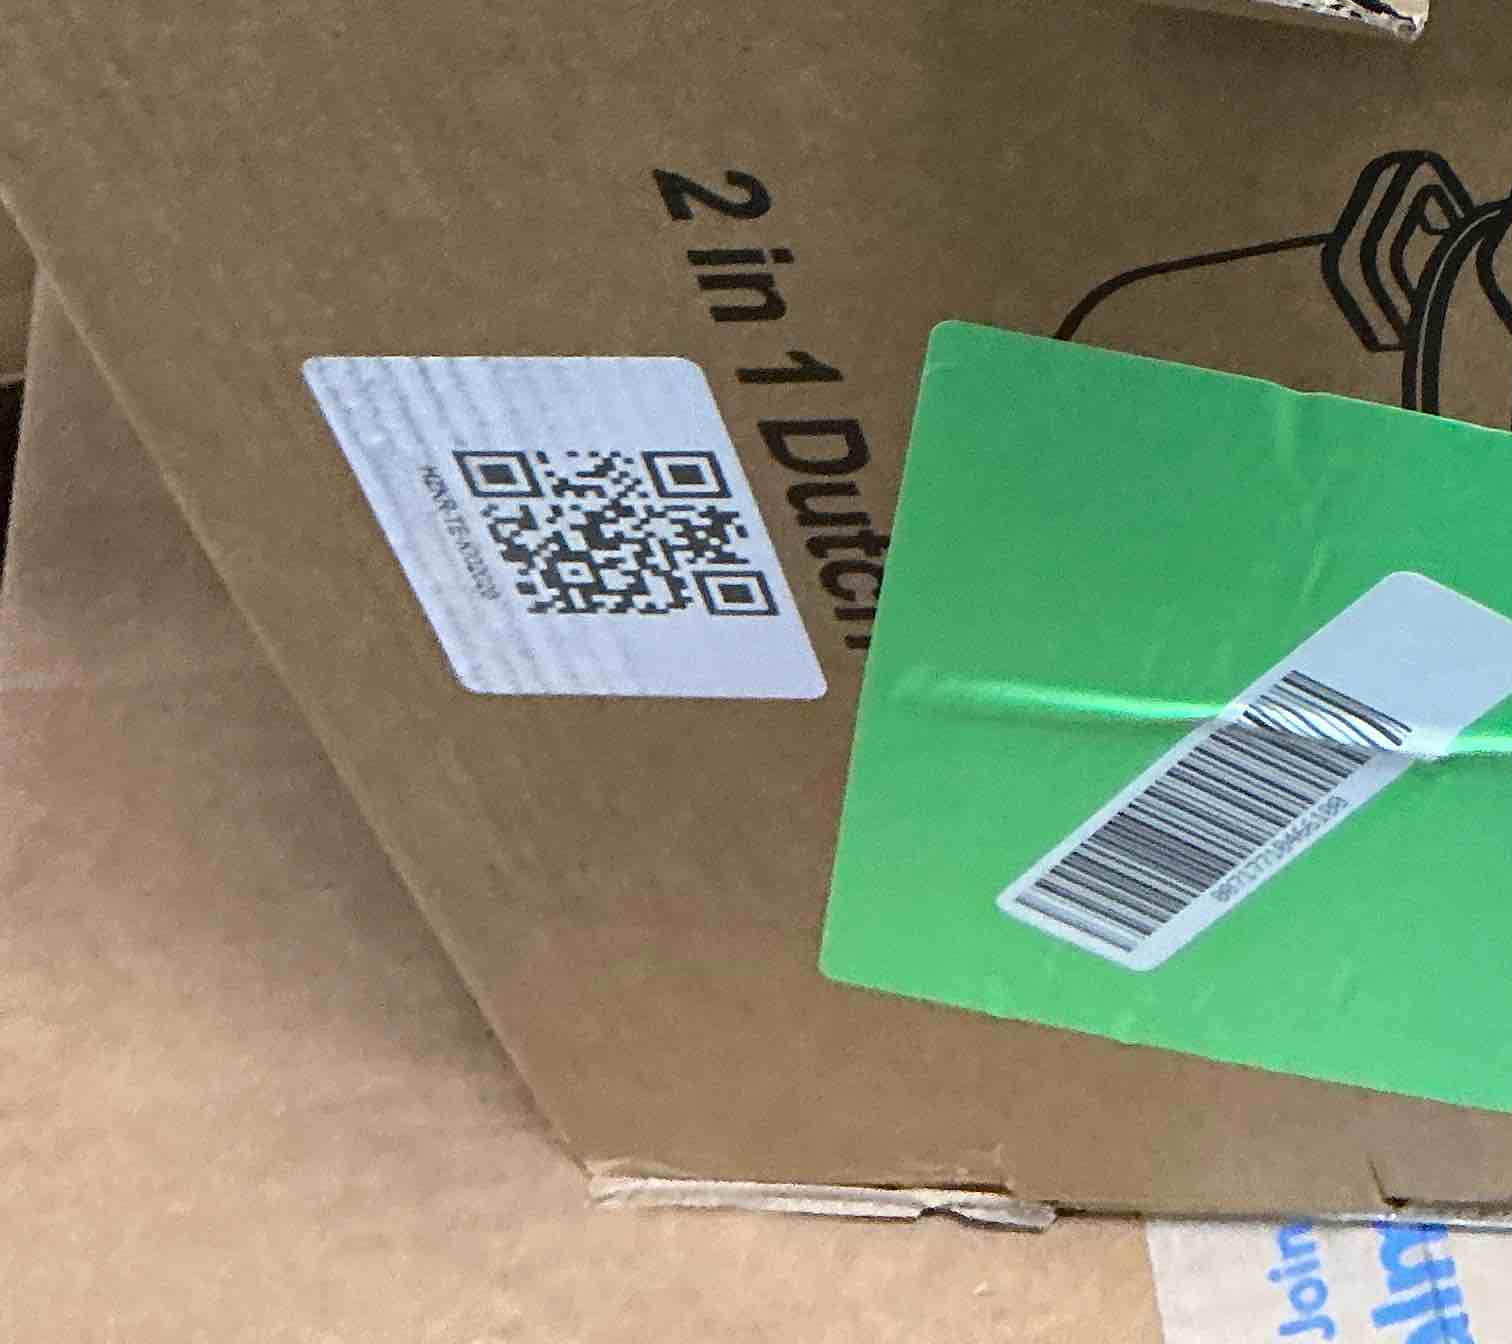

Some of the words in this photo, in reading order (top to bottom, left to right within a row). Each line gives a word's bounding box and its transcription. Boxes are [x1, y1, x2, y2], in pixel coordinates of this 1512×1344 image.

[652, 167, 772, 222] 2
[686, 247, 795, 323] in
[735, 349, 844, 385] 1
[1267, 1217, 1335, 1340] Join
